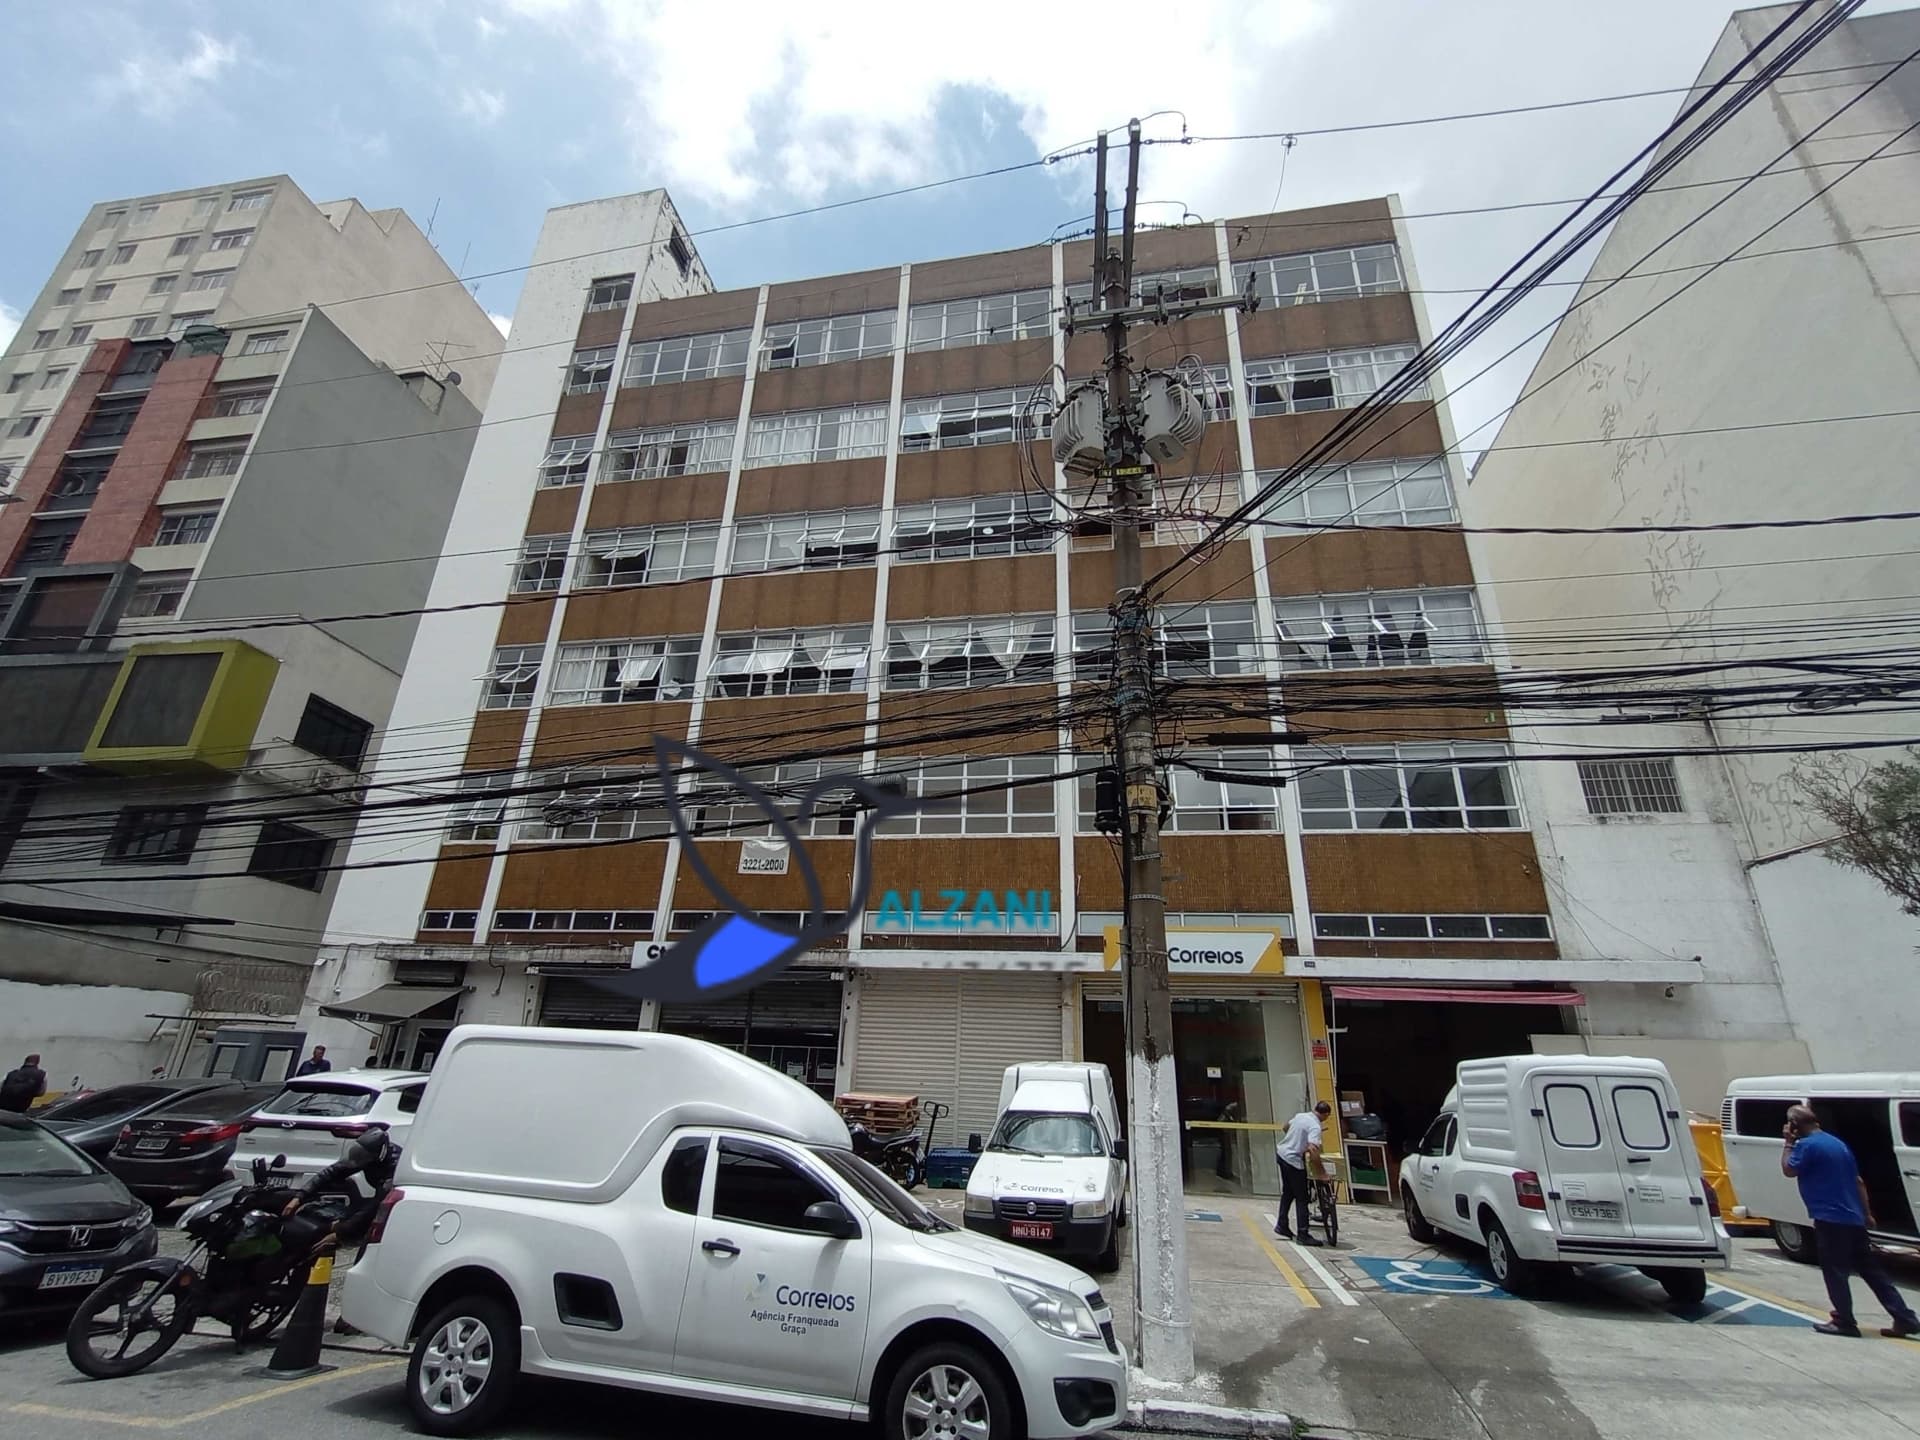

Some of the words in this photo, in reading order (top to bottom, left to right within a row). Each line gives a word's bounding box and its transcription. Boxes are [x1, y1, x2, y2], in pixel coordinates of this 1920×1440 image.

[742, 858, 785, 871] 3221-2000
[1168, 946, 1244, 964] Correios
[1020, 1183, 1064, 1194] Correios
[776, 1285, 855, 1312] Correios
[751, 1309, 786, 1322] Agência
[787, 1313, 839, 1328] Franqueada
[780, 1322, 807, 1336] Graça
